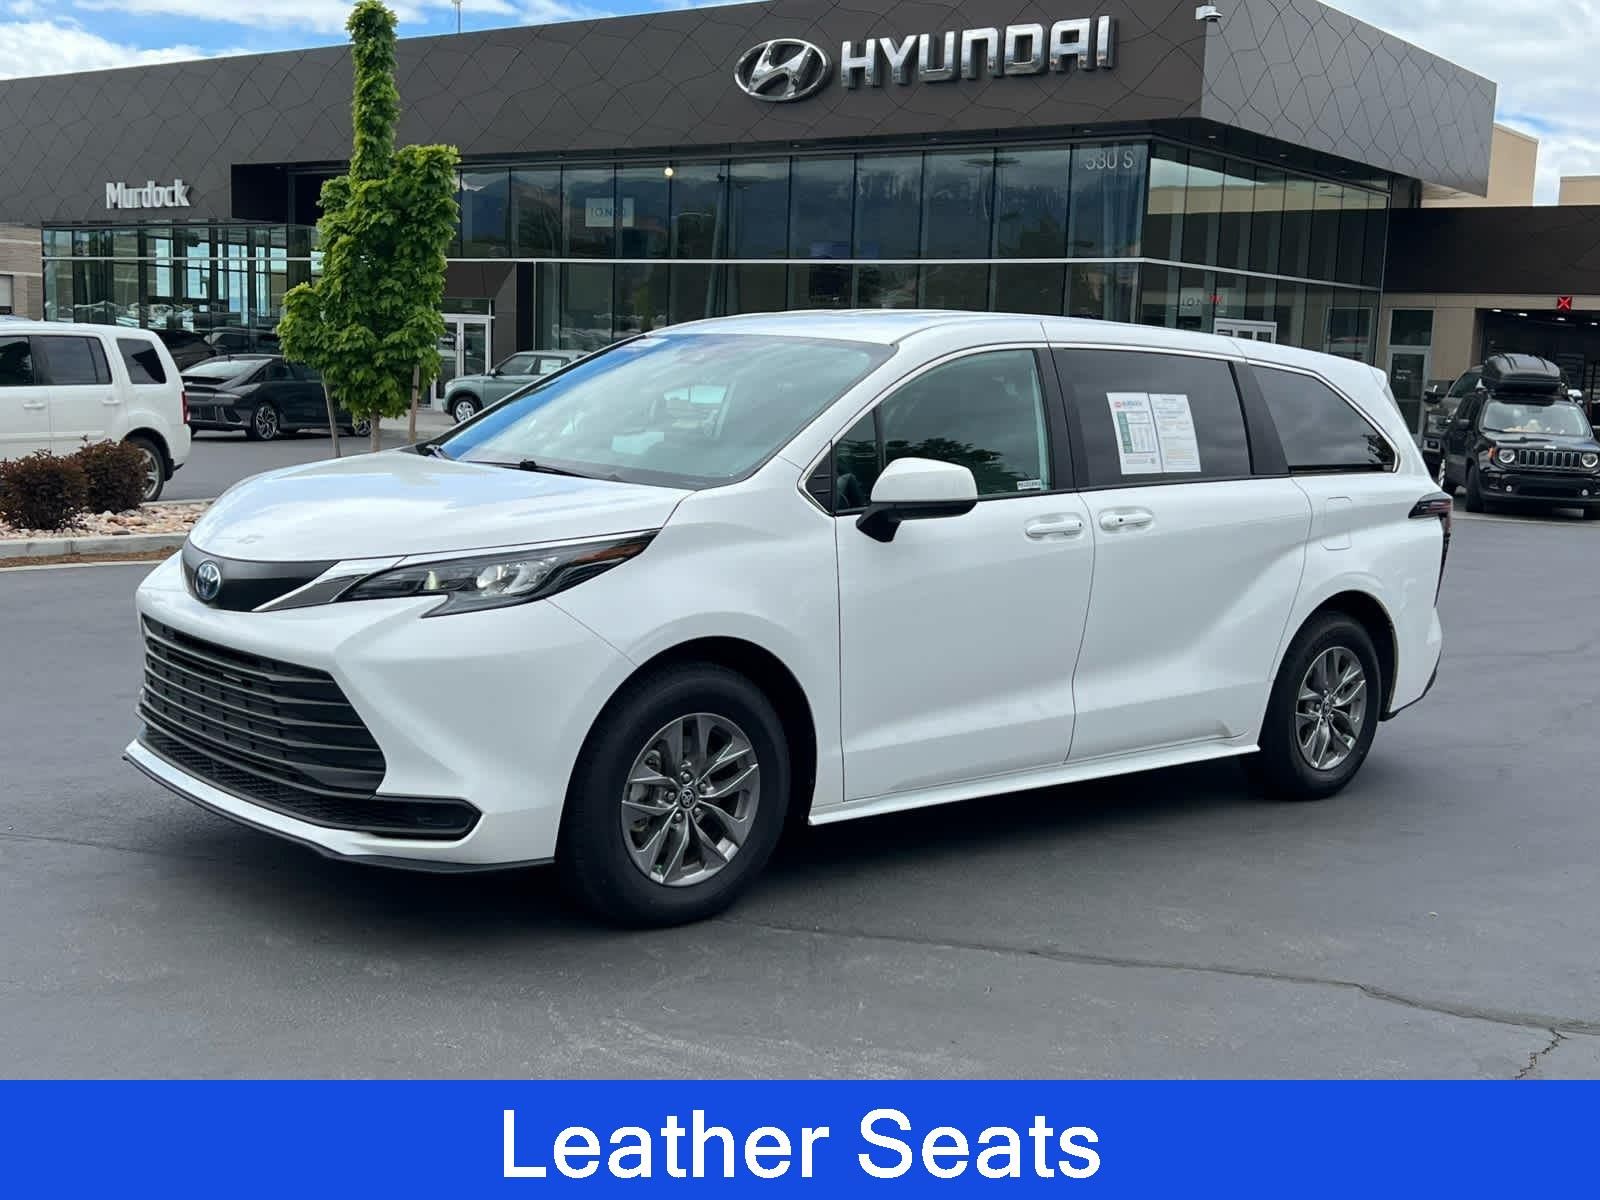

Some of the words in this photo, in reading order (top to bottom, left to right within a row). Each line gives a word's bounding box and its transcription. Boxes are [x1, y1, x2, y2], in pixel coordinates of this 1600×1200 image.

[840, 15, 1114, 89] HYUNDAI
[1123, 150, 1134, 169] S
[105, 179, 191, 209] Murdock
